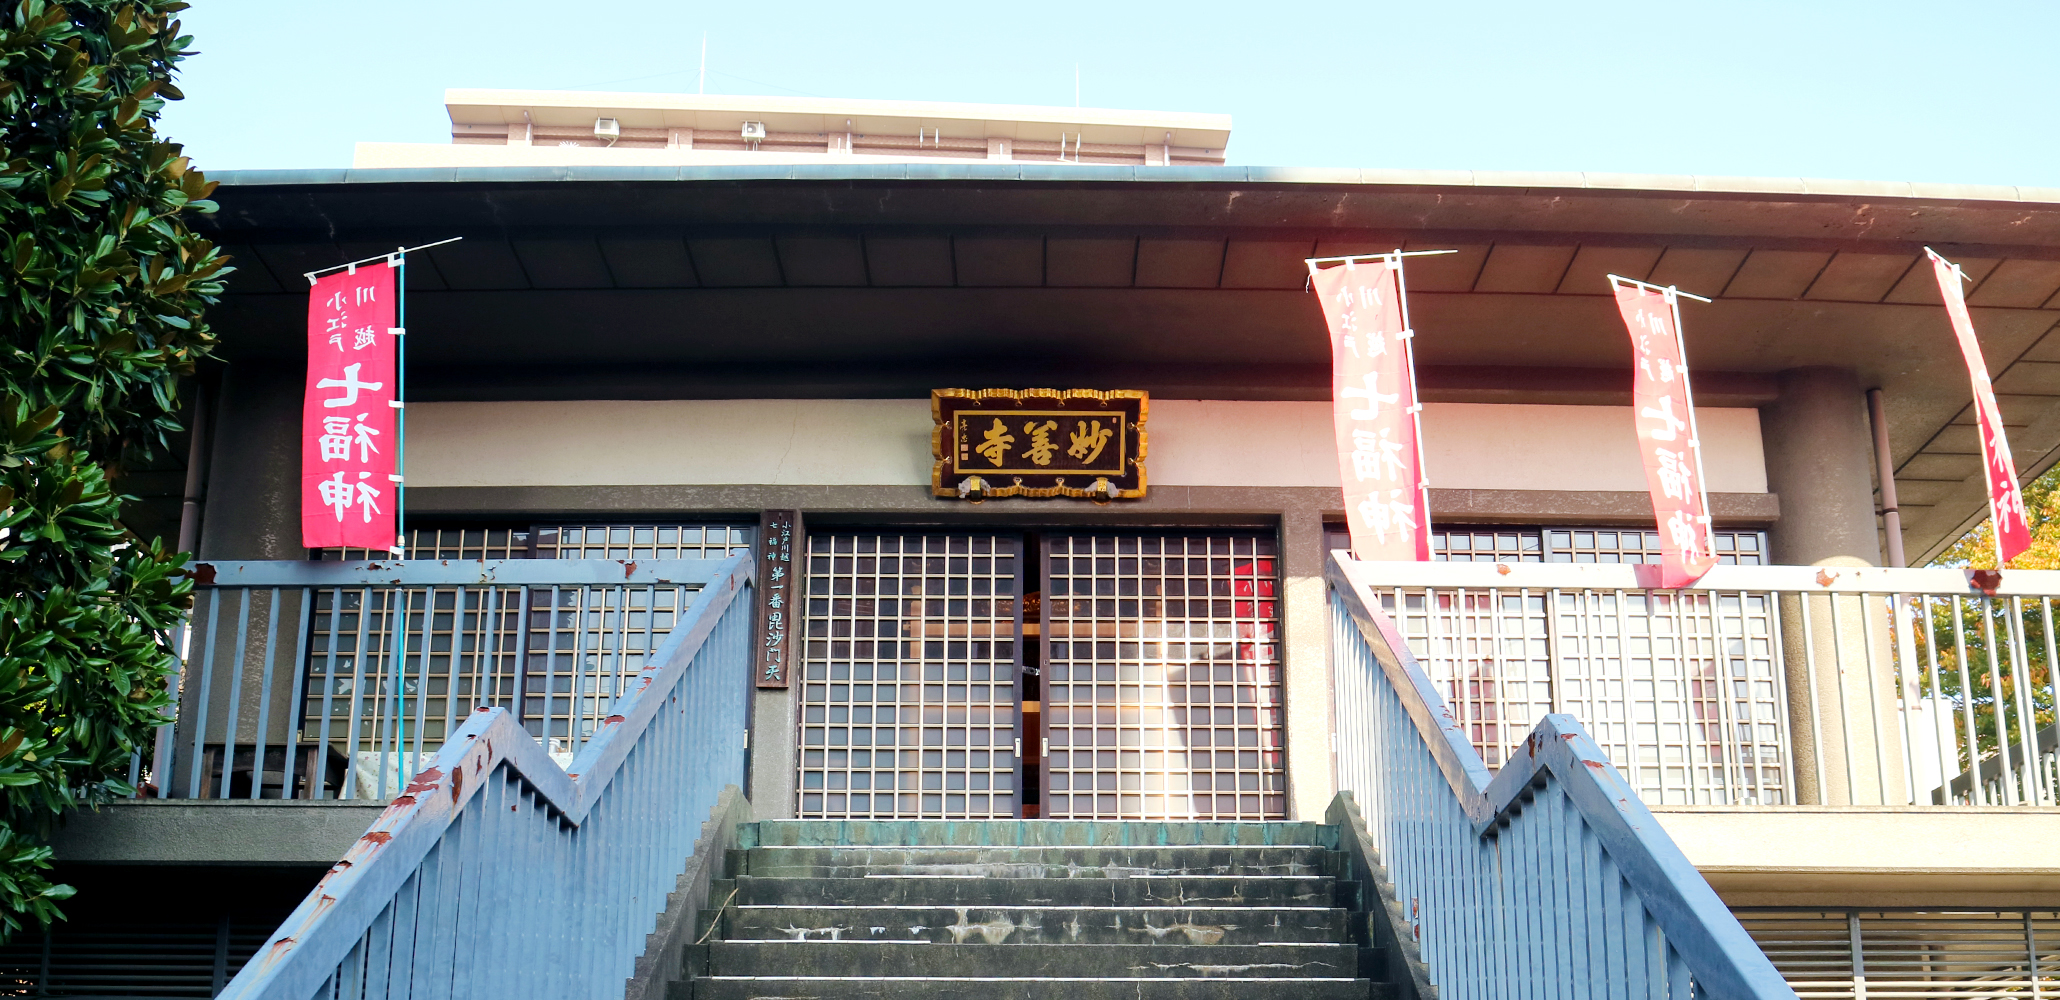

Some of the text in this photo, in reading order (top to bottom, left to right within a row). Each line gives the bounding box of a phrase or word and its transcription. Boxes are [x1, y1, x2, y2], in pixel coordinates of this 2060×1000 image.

[975, 418, 1113, 467] 妙善寺
[767, 521, 778, 561] 七福神
[780, 521, 792, 561] 小江戸川越
